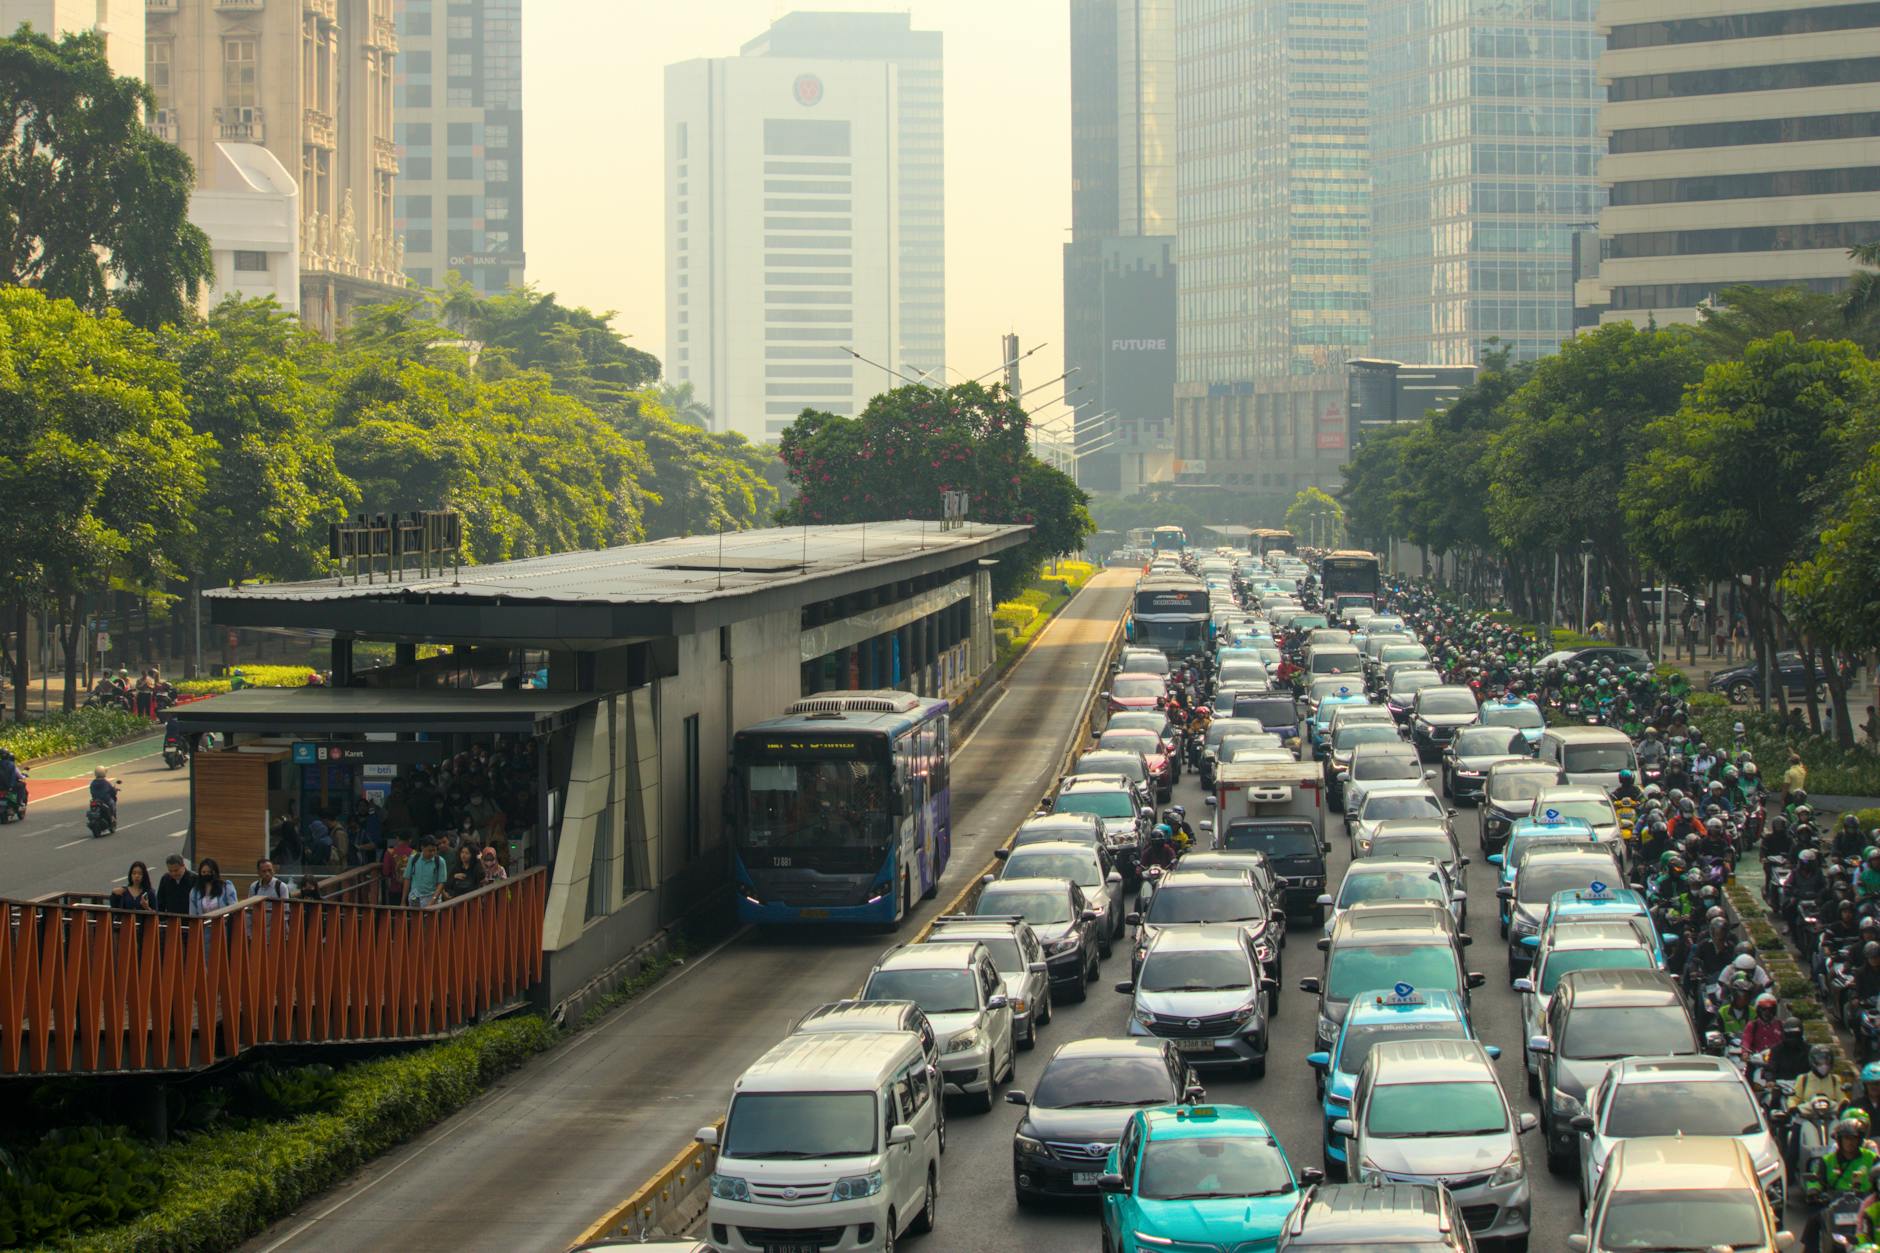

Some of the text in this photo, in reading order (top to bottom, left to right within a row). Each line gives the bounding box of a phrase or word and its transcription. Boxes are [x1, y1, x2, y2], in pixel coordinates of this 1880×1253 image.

[450, 256, 465, 265] OK
[473, 256, 497, 265] BANK
[1112, 339, 1167, 351] FUTURE
[344, 750, 364, 758] Karet
[1382, 1023, 1424, 1031] Bluebird
